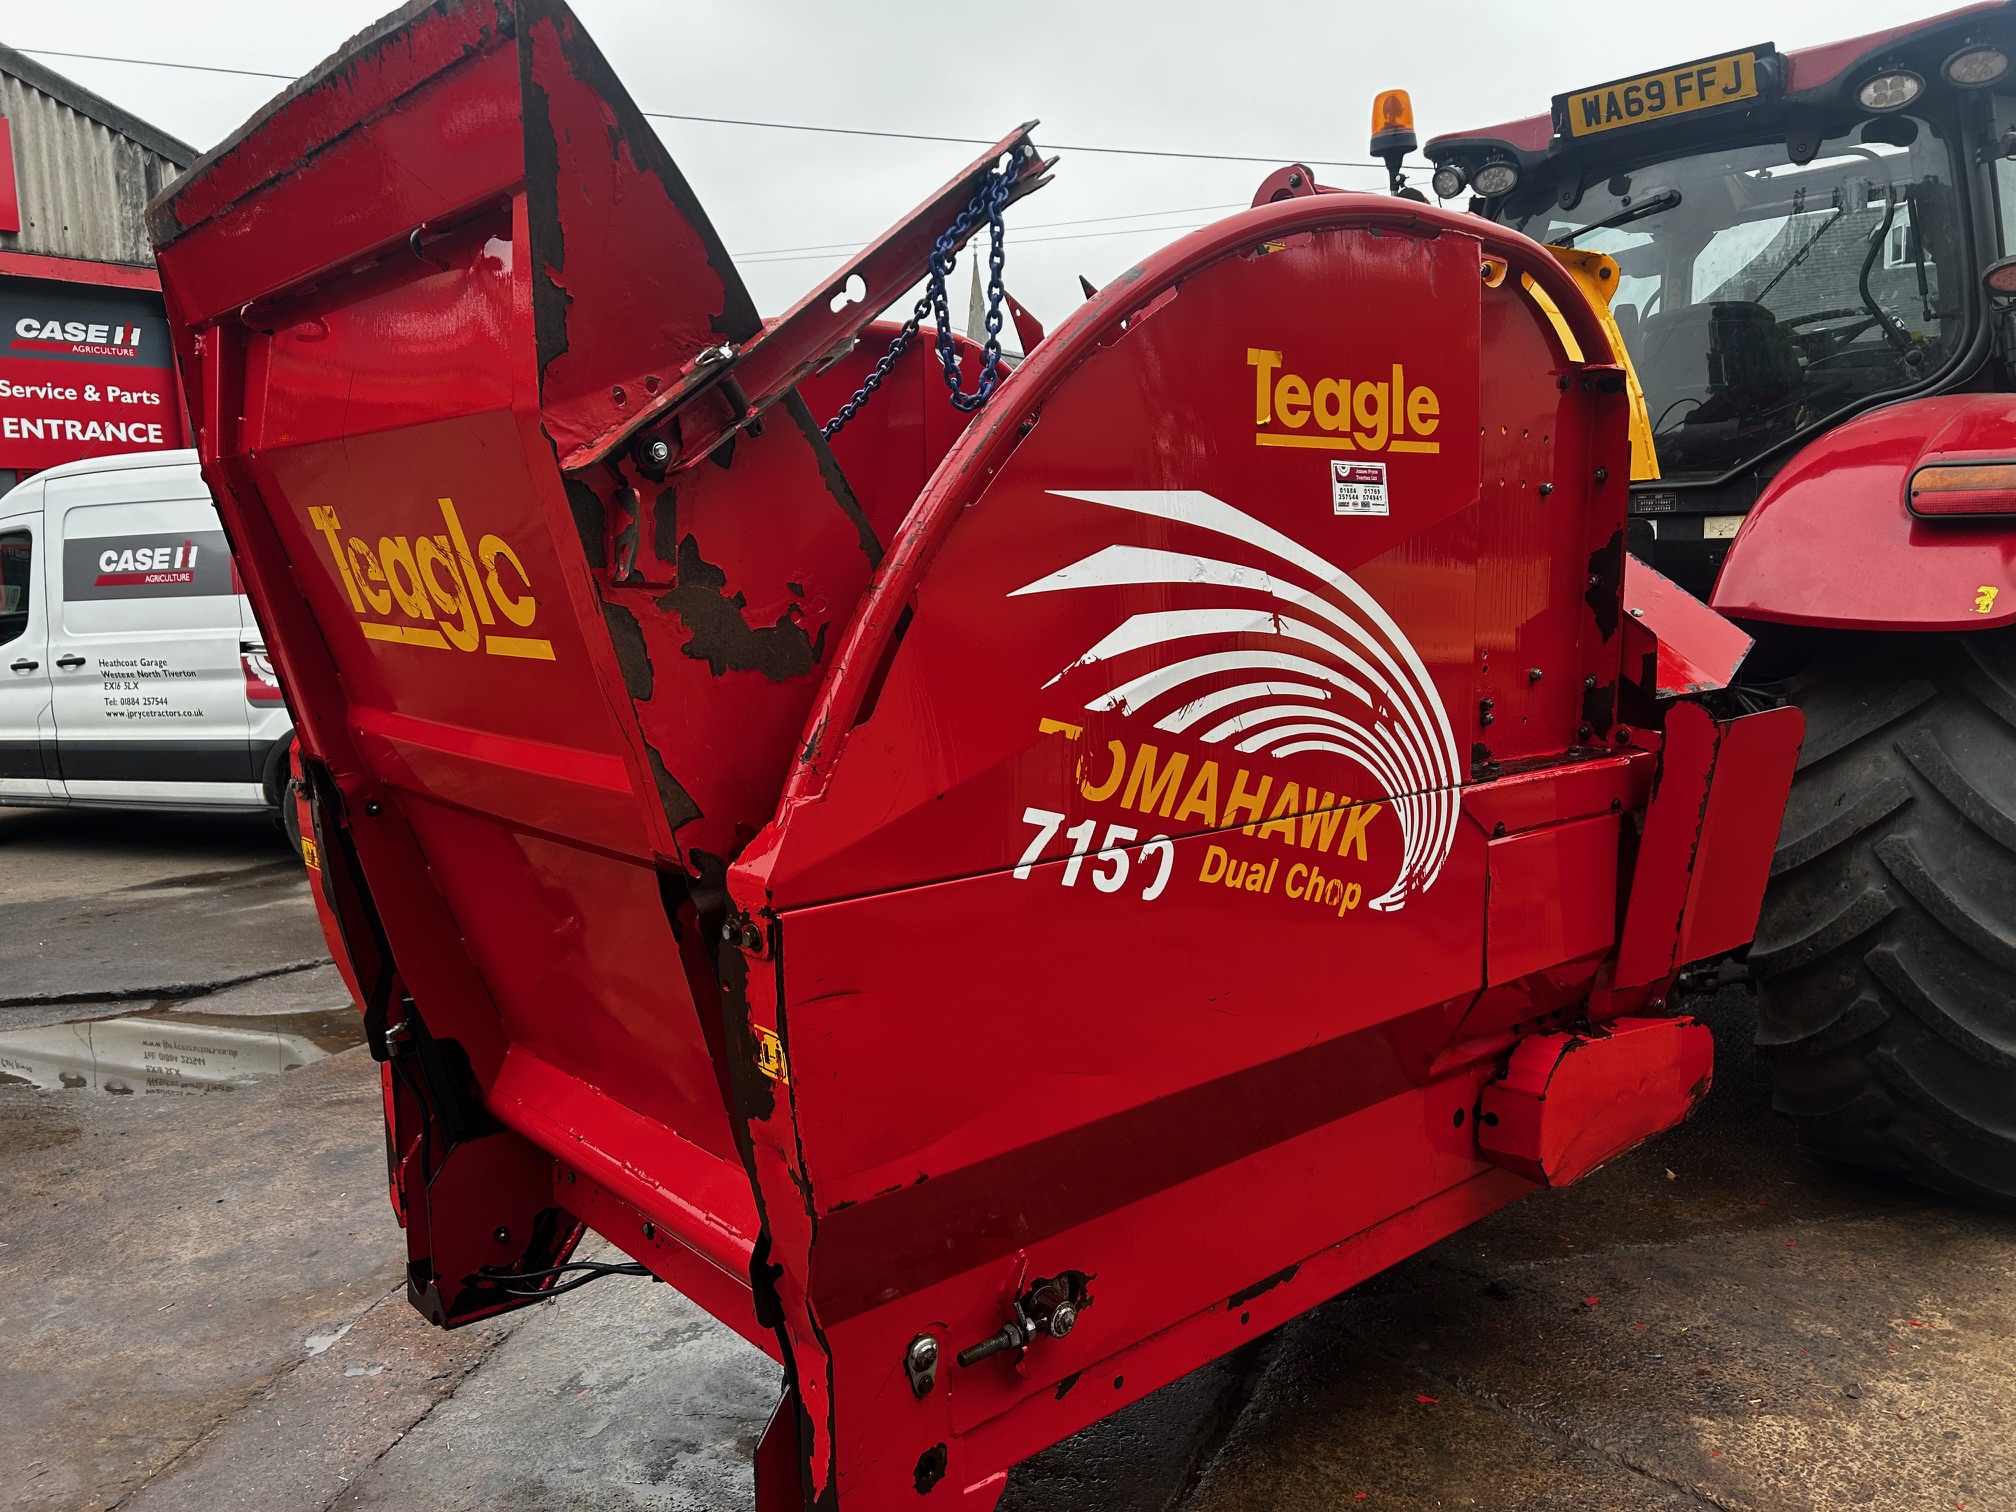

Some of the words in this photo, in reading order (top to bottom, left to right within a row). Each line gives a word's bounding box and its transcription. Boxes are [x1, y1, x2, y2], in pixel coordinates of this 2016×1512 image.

[1581, 79, 1667, 128] WA69
[1673, 60, 1742, 107] FFJ
[15, 318, 109, 344] CASE
[72, 345, 134, 357] AGRICULTURE
[0, 380, 78, 401] Service
[83, 384, 101, 402] &
[107, 386, 160, 405] Parts
[1247, 347, 1440, 451] Teagle
[2, 417, 164, 443] ENTRANCE
[99, 547, 171, 572] CASE
[145, 573, 190, 583] AGRICULTURE
[98, 658, 137, 667] Heathcoat
[140, 658, 167, 669] Garage
[101, 670, 135, 679] Westexe
[137, 669, 161, 678] North
[162, 669, 196, 678] Tiverton
[104, 681, 121, 690] EX16
[123, 681, 139, 690] 5LX
[104, 697, 118, 706] Tel:
[120, 697, 140, 706] 01884
[142, 697, 168, 706] 257544
[105, 708, 204, 719] www.jprycetractors.co.uk
[1199, 845, 1279, 894] Dual
[1285, 863, 1362, 917] Chop
